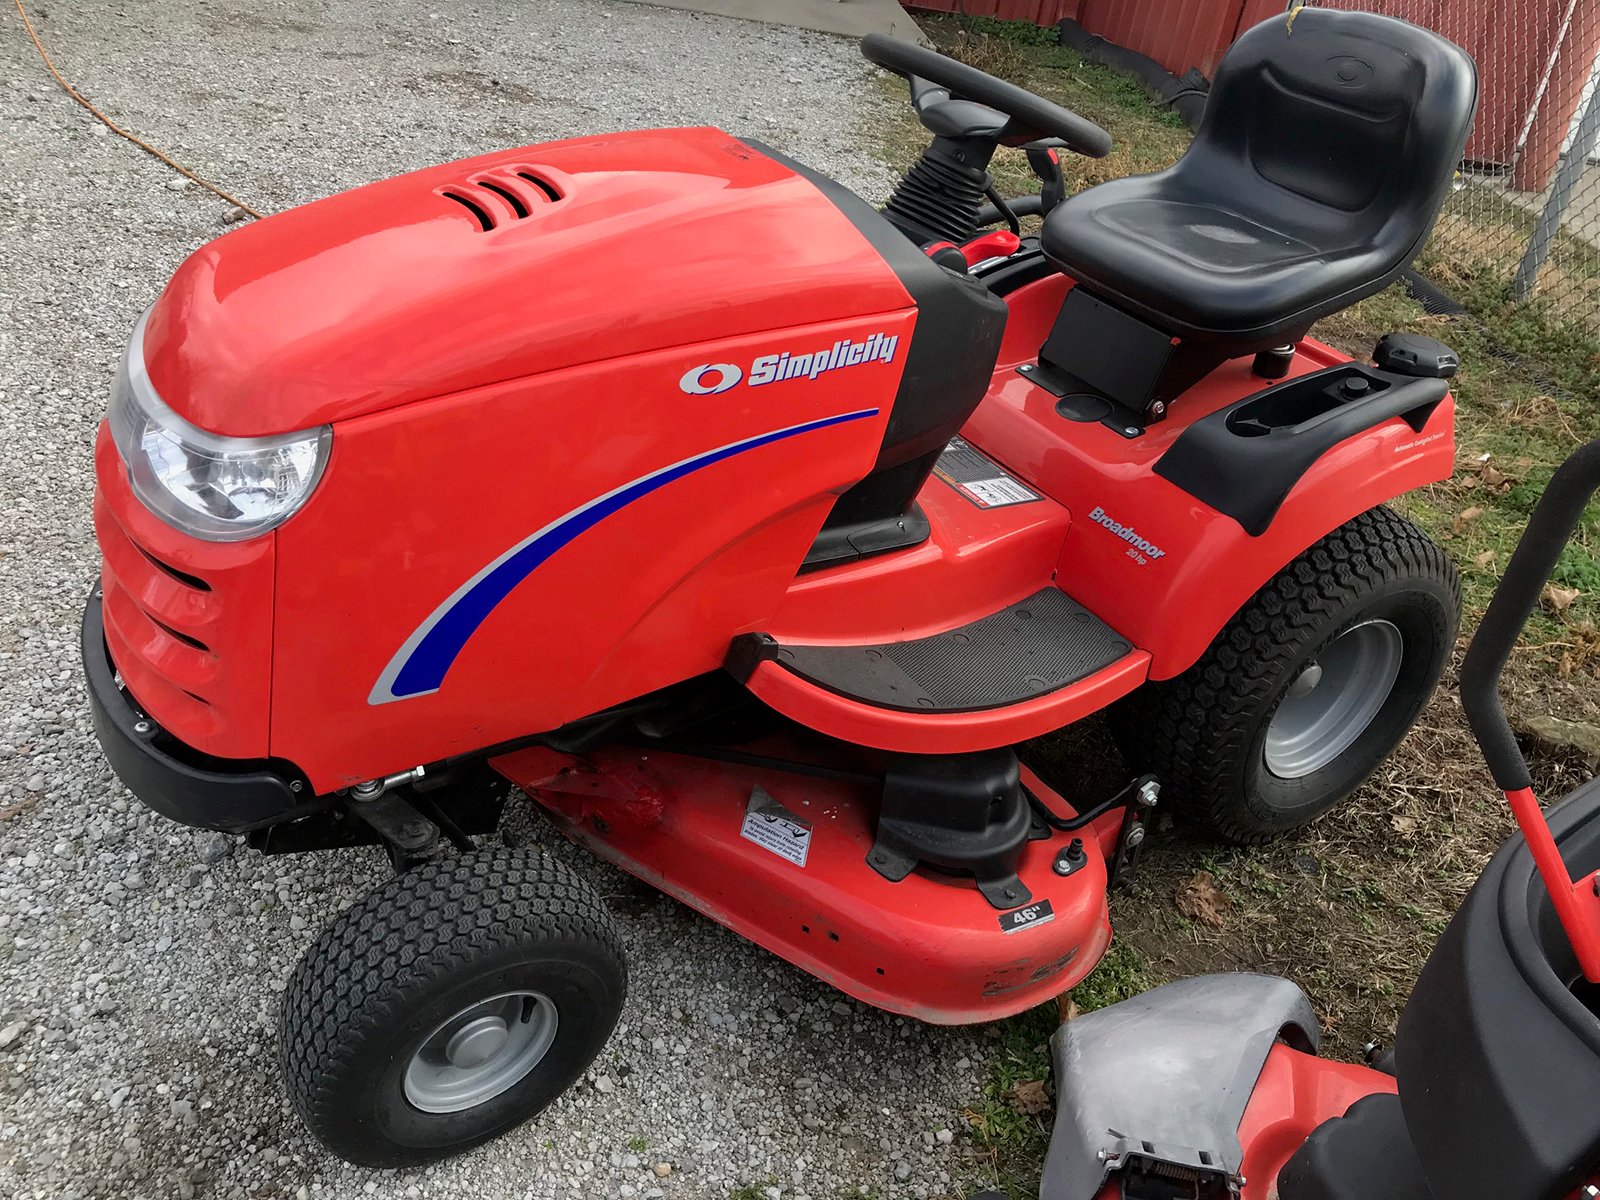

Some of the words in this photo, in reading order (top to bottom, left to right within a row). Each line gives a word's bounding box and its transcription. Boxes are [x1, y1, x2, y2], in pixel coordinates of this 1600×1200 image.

[748, 332, 898, 386] Simplicity
[1088, 506, 1165, 559] Broadmoor
[1125, 548, 1138, 559] 20
[1135, 554, 1148, 565] hp
[748, 819, 782, 839] Amputation
[782, 837, 804, 850] Hazard
[754, 828, 765, 837] avoid
[764, 834, 776, 842] injury
[1014, 905, 1041, 924] 46"
